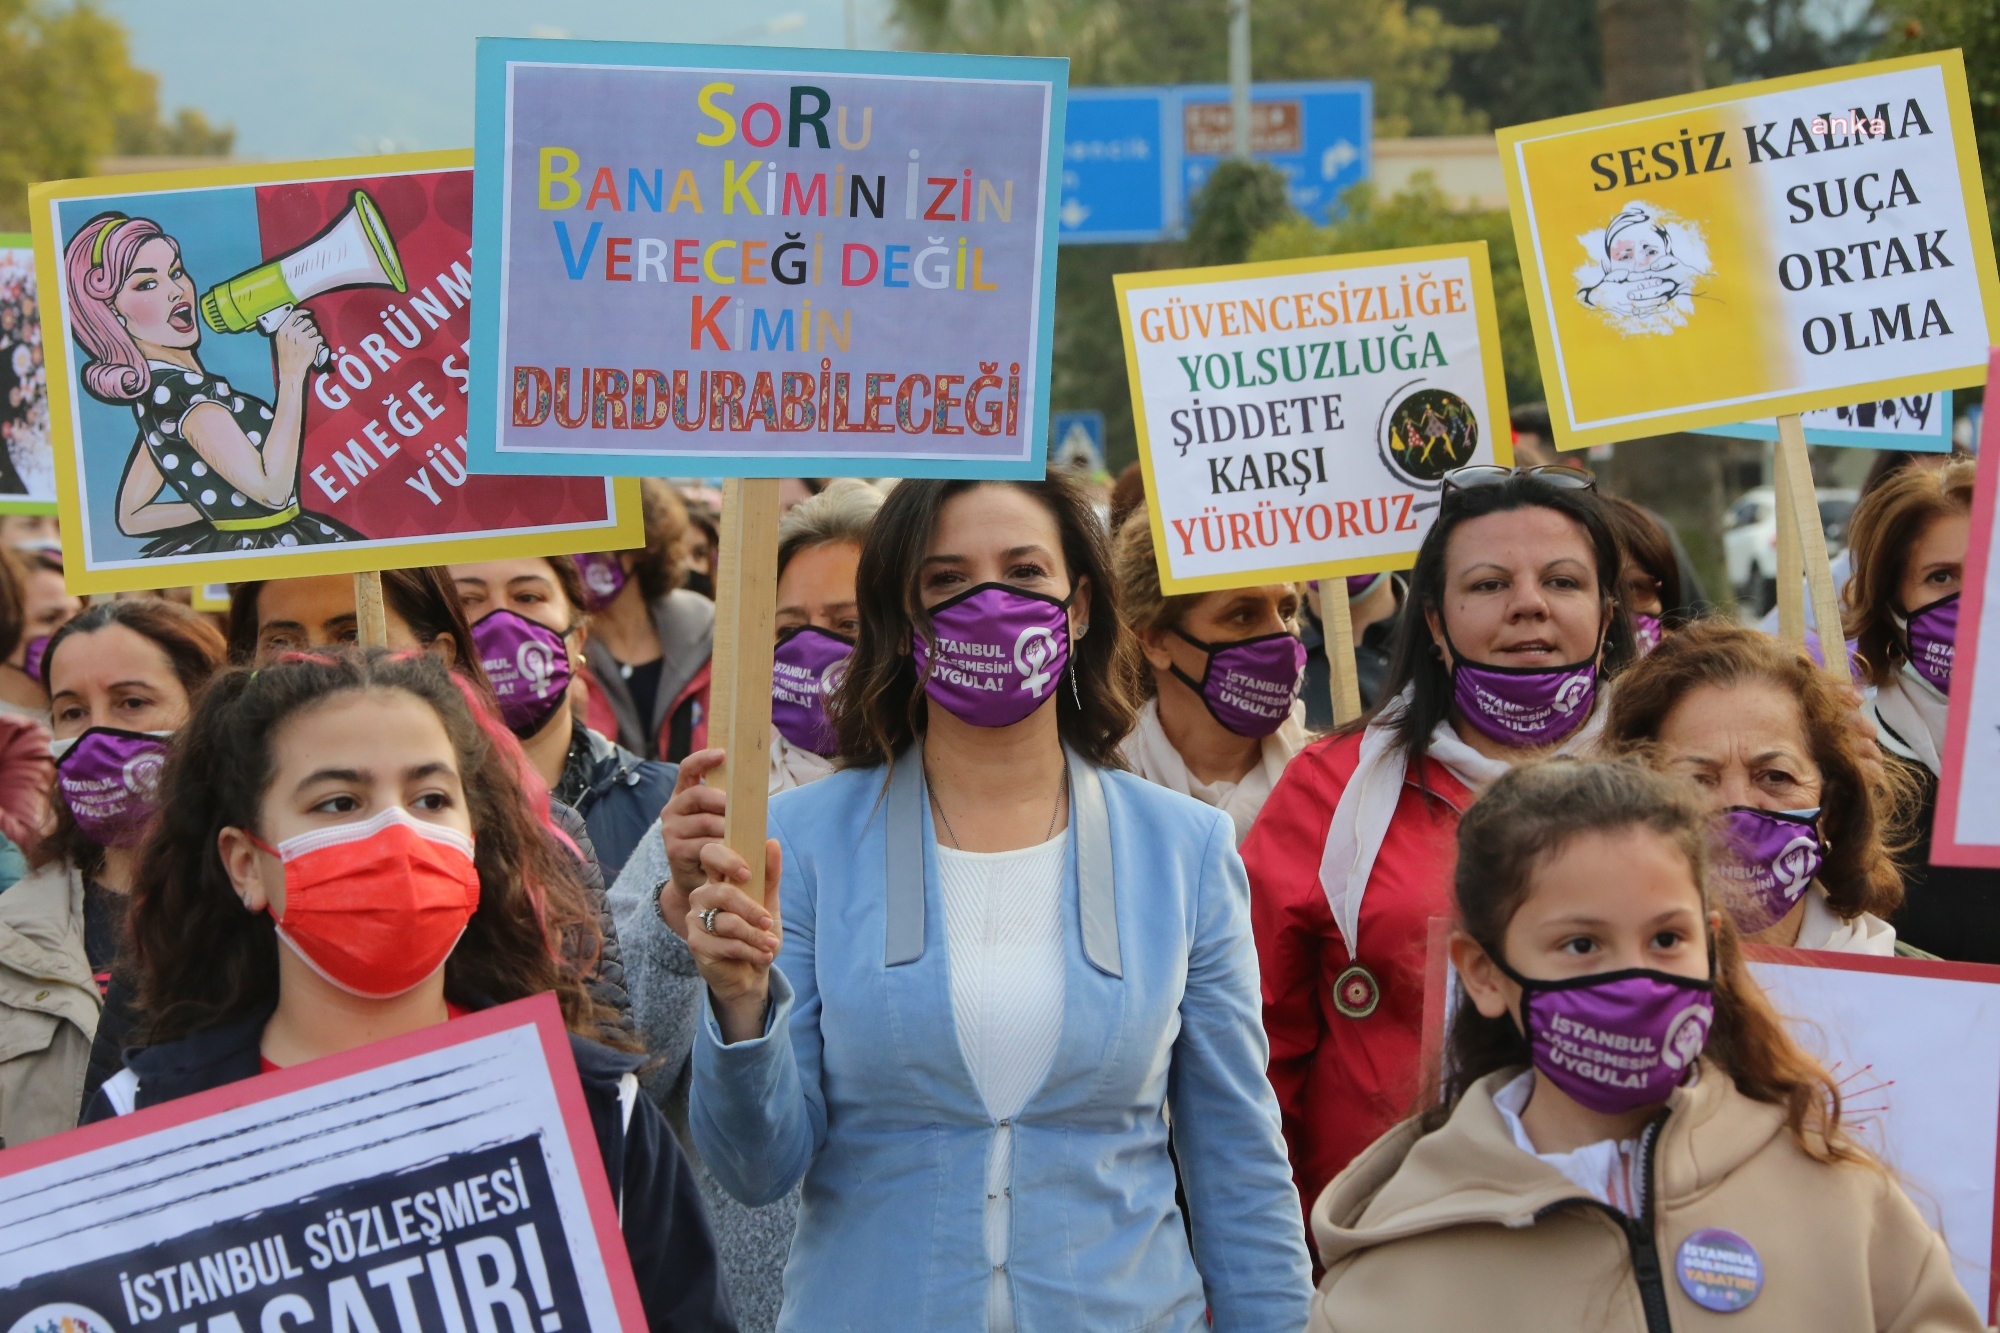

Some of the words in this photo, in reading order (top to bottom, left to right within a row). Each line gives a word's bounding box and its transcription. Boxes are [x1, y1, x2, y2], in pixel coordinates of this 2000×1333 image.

[1590, 129, 1731, 192] SESİZ
[1743, 98, 1933, 166] KALMA
[538, 147, 703, 214] BANA
[722, 160, 885, 219] KİMİN
[905, 149, 1013, 222] İZİN
[1786, 168, 1921, 224] SUÇA
[553, 221, 822, 286] VERECEĞİ
[841, 236, 997, 290] DEĞİL
[1778, 229, 1954, 291] ORTAK
[315, 247, 472, 410] GÖRÜNM
[690, 295, 851, 352] KİMİN
[1140, 272, 1467, 343] GÜVENCESİZLİĞE
[1802, 299, 1954, 355] OLMA
[1178, 324, 1449, 392] YOLSUZLUĞA
[309, 381, 446, 503] EMEĞE
[441, 339, 470, 394] S
[512, 358, 1021, 437] DURDURABİLECEĞİ
[1170, 394, 1345, 457] ŞİDDETE
[405, 430, 468, 506] YÜ
[1208, 447, 1328, 496] KARŞI
[1171, 494, 1418, 556] YÜRÜYORUZ
[1220, 690, 1283, 718] UYGULA!
[1226, 669, 1289, 694] İSTANBUL
[1551, 1012, 1656, 1053] İSTANBUL
[1549, 1047, 1649, 1089] UYGULA!
[119, 1233, 303, 1326] İSTANBUL
[304, 1157, 532, 1271] SÖZLEŞMESİ
